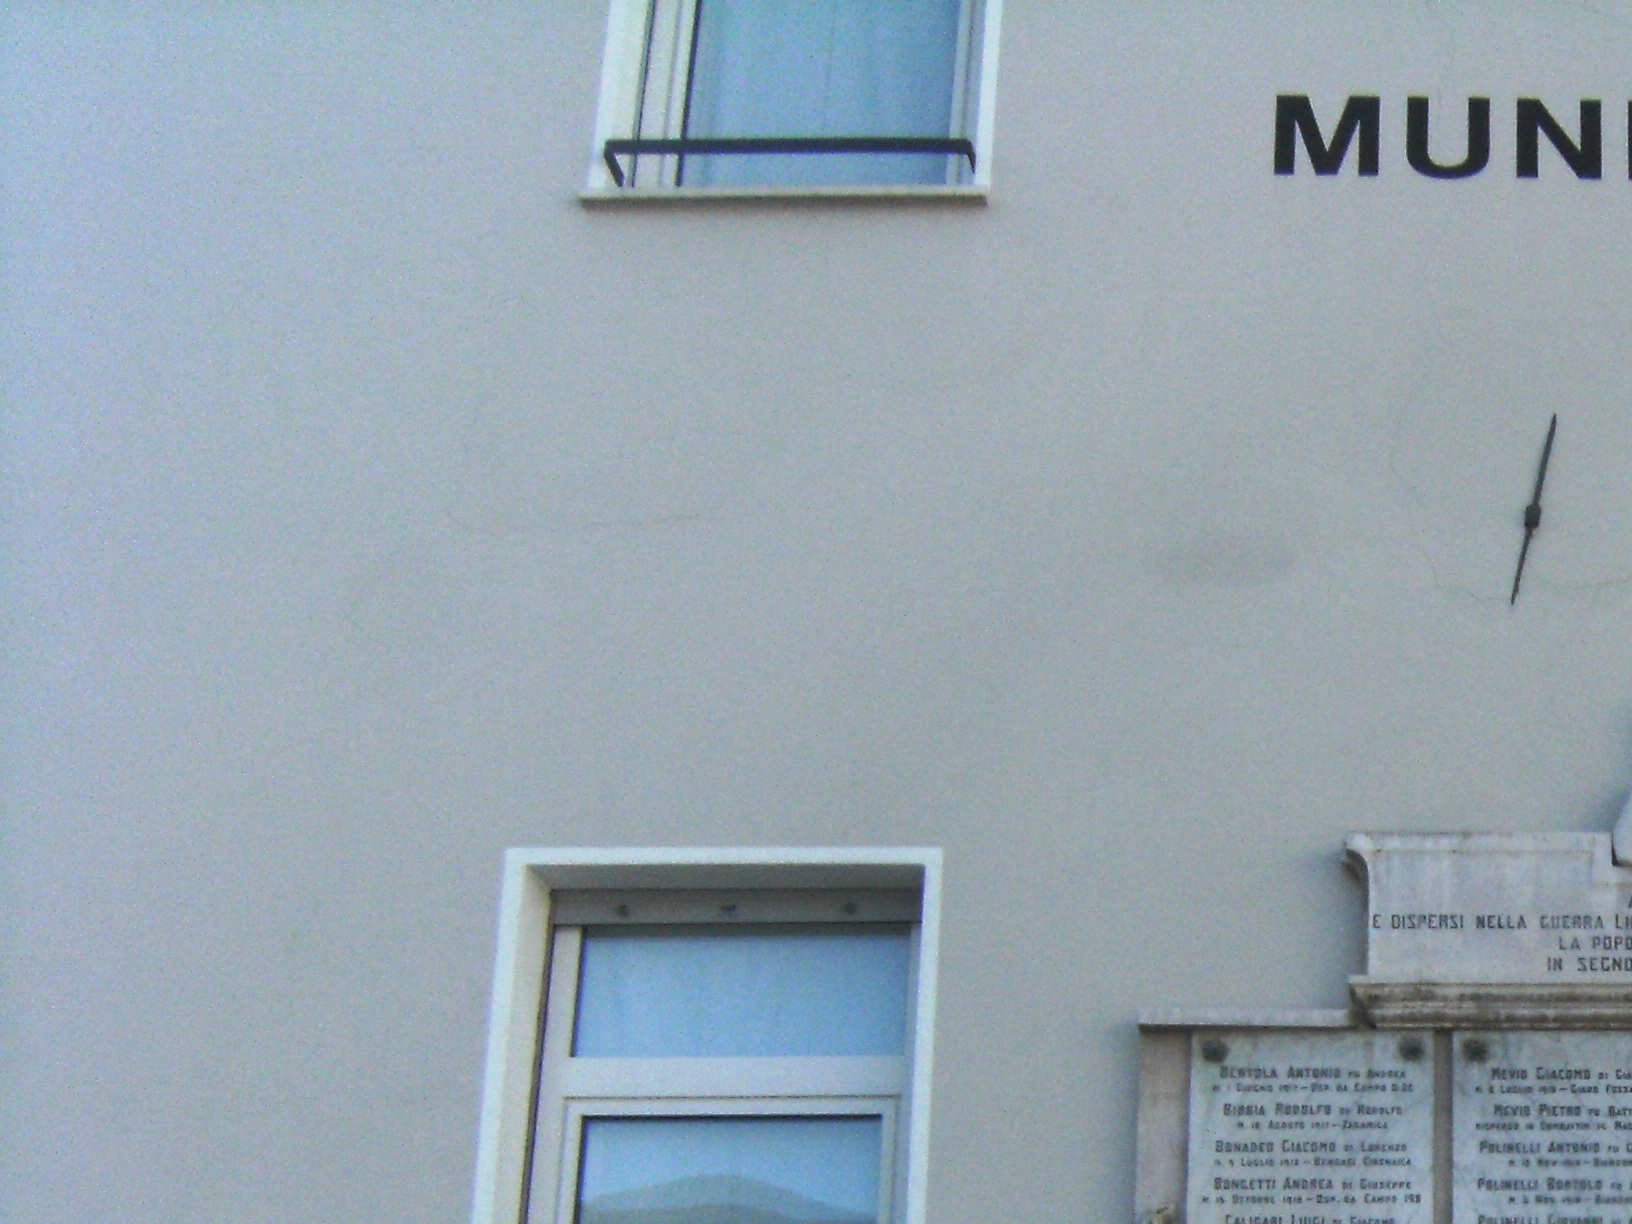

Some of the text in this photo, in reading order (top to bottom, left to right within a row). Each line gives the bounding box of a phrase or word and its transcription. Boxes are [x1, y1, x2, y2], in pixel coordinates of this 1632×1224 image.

[1373, 914, 1381, 929] E
[1391, 914, 1463, 929] DISPERSI
[1476, 915, 1526, 929] NELLA
[1540, 915, 1604, 929] GUERRA
[1559, 937, 1580, 950] LA
[1548, 958, 1562, 971] IN
[1578, 957, 1632, 971] SEGNO
